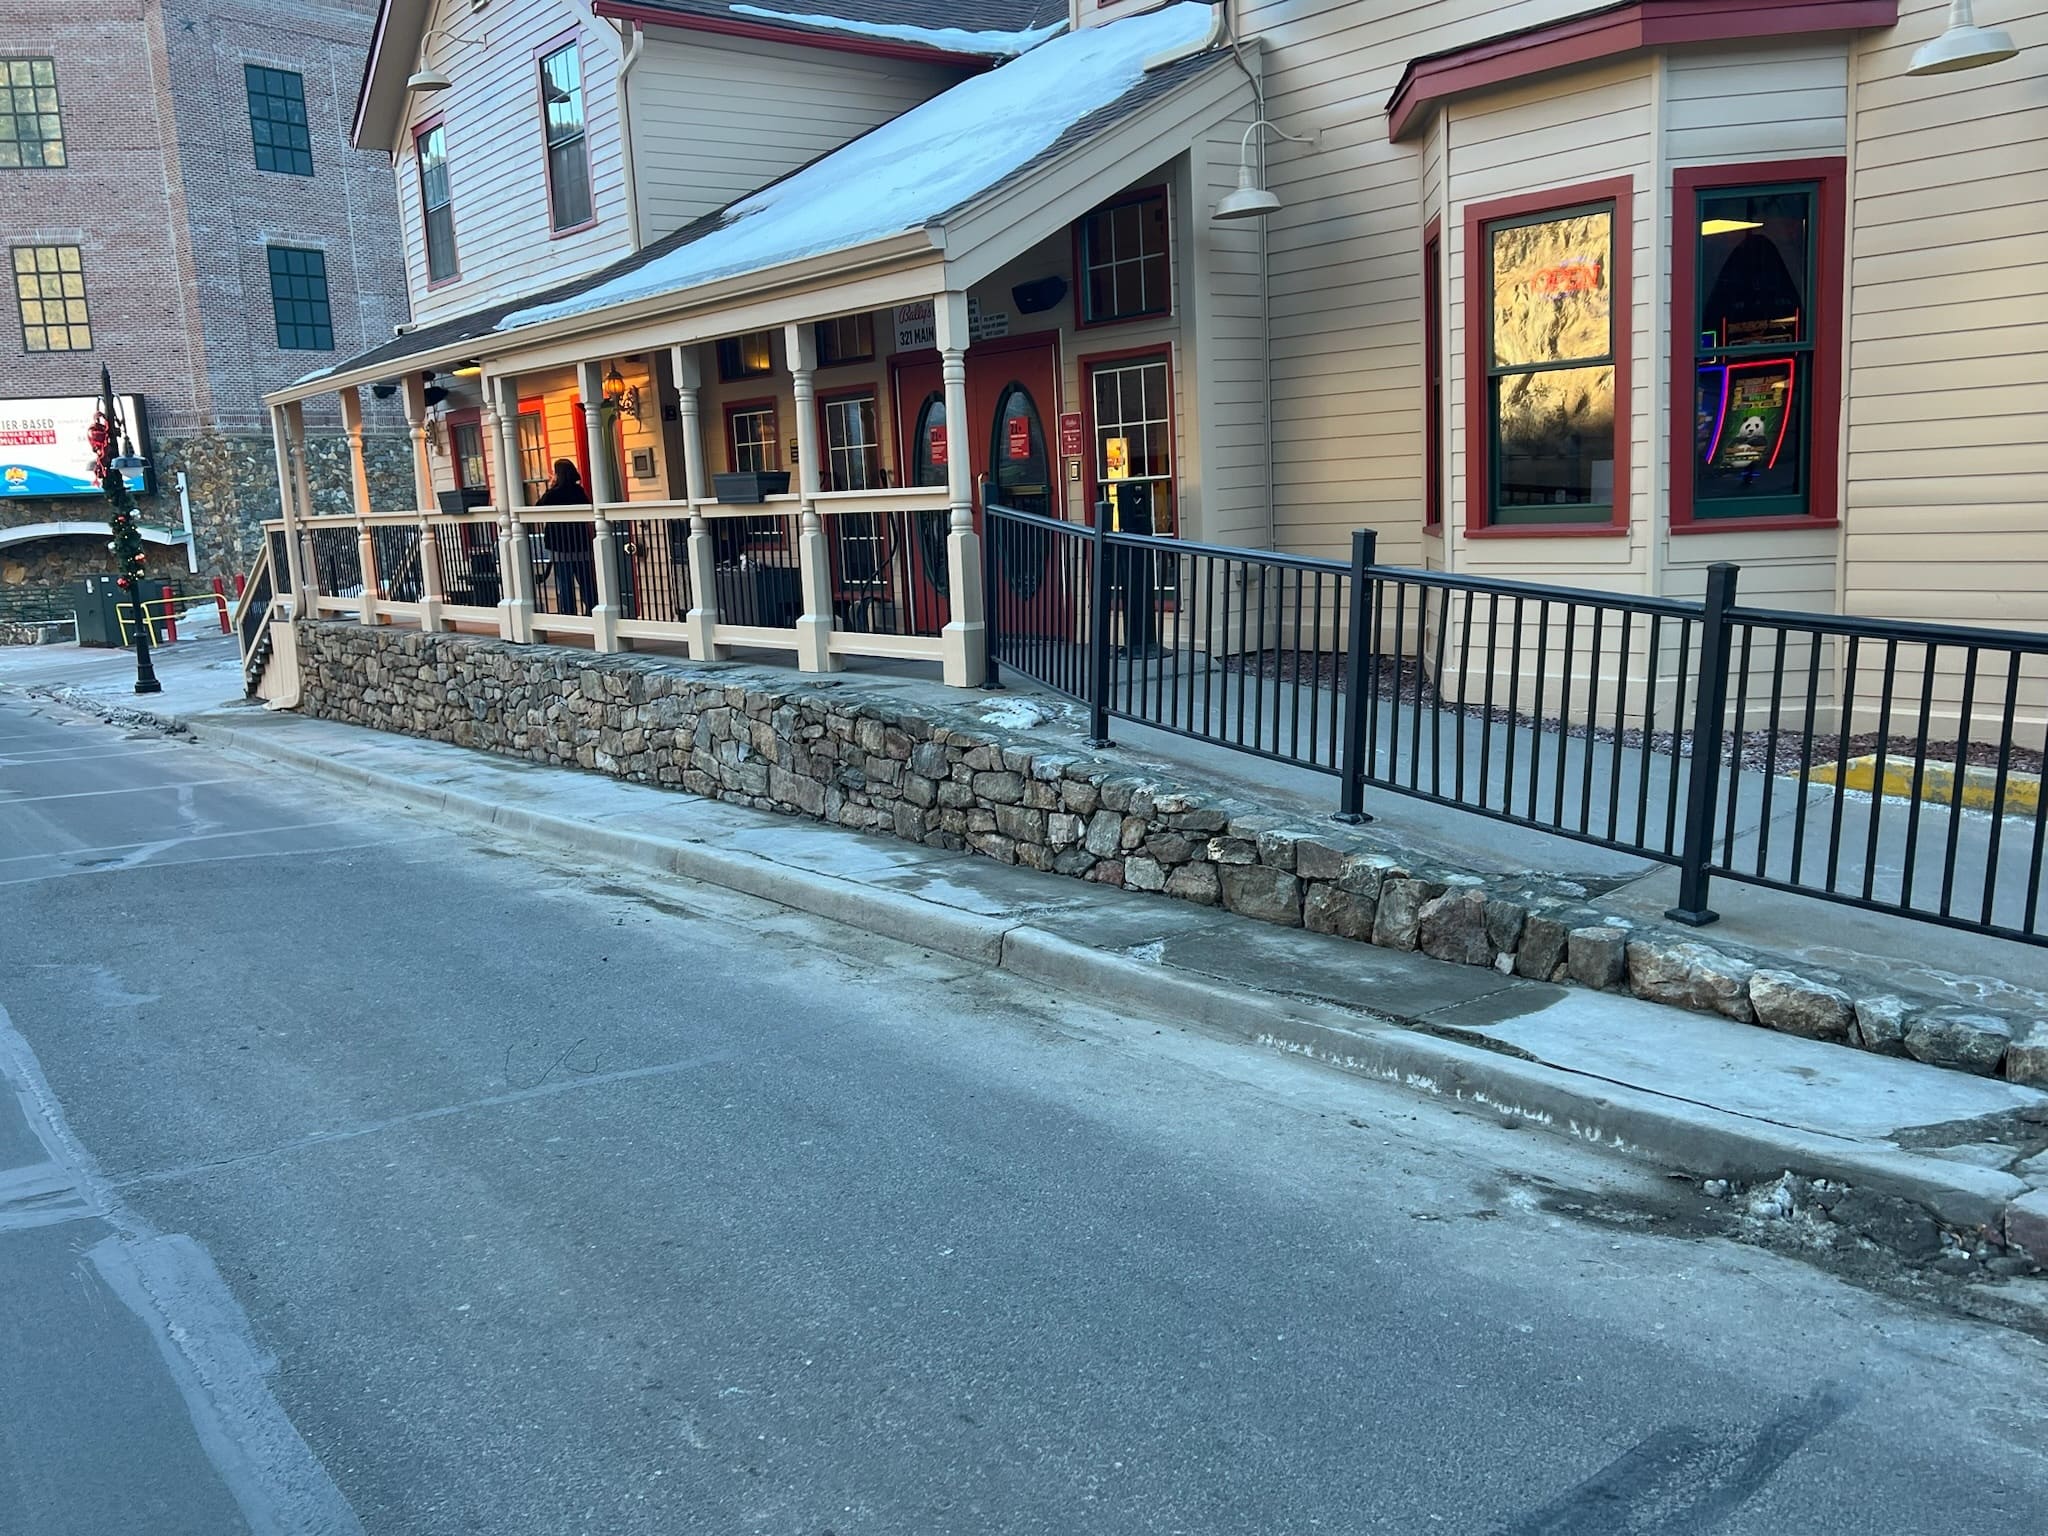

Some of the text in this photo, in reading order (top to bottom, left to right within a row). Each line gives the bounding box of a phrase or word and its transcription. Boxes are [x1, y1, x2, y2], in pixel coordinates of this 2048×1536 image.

[1531, 264, 1600, 293] OPEN
[898, 302, 932, 324] Bally's
[900, 326, 935, 346] 321 MAIN
[1, 418, 54, 430] IER-BASED
[0, 436, 55, 445] MULTIPLIER
